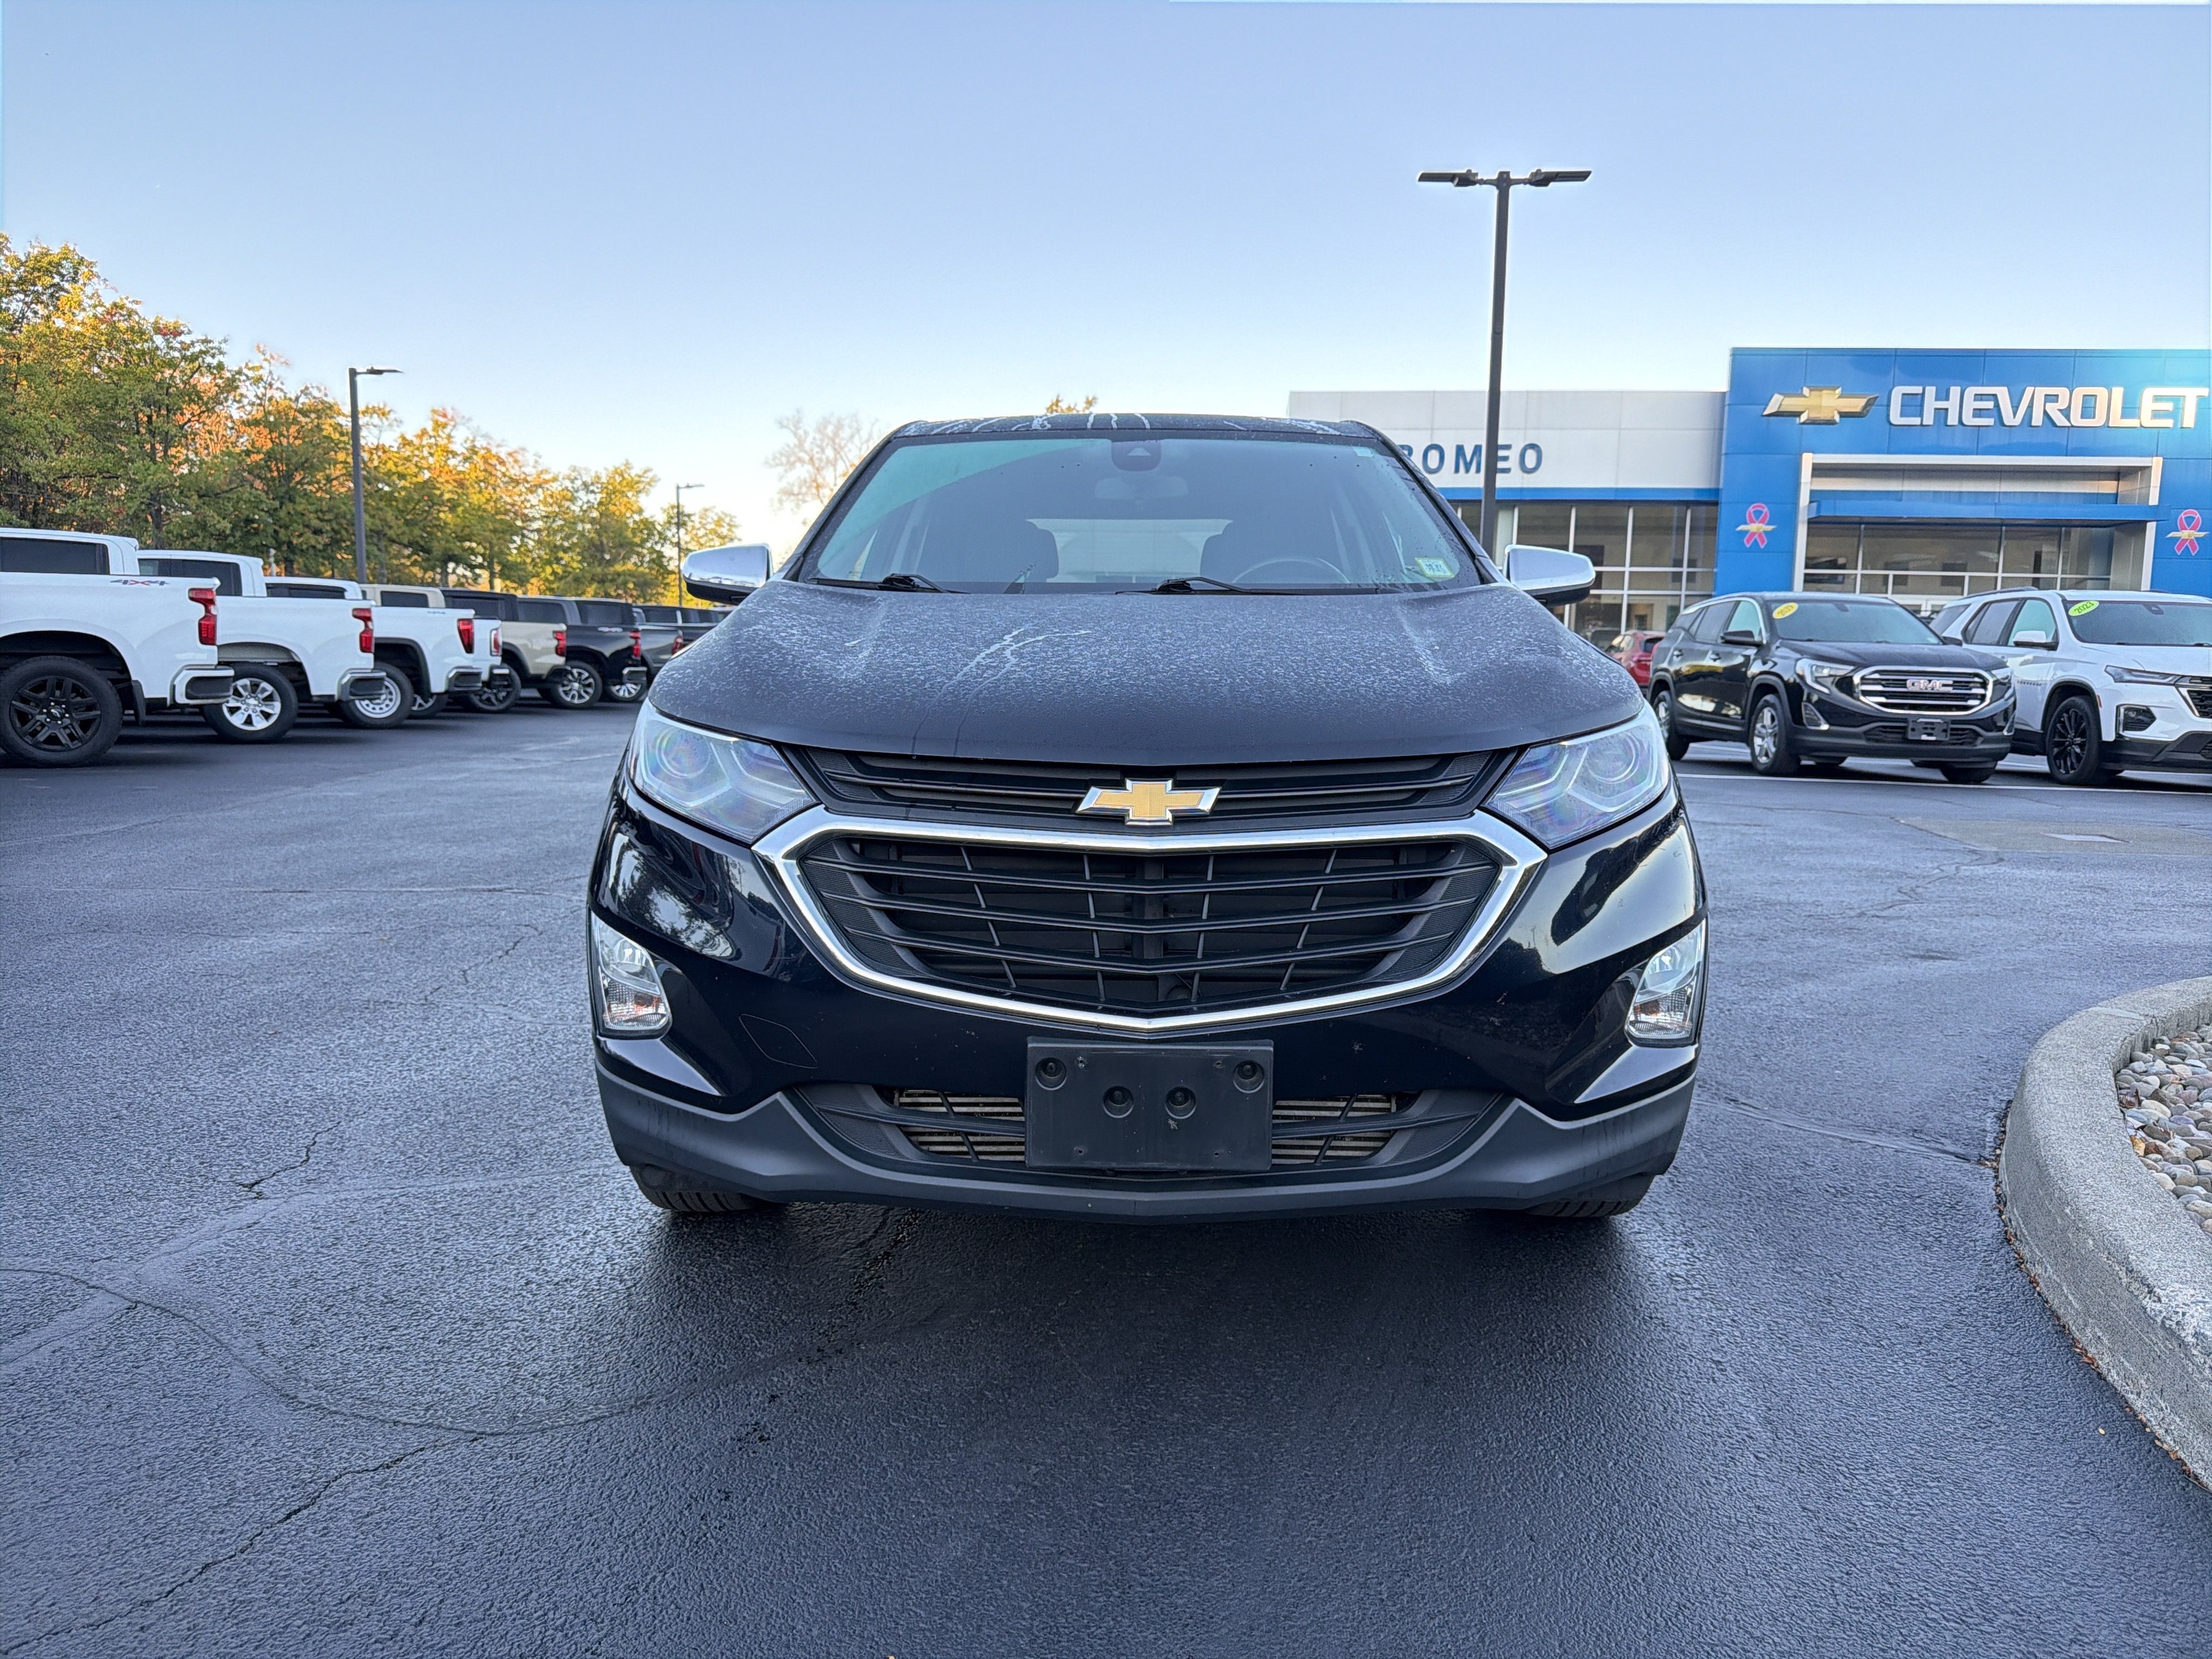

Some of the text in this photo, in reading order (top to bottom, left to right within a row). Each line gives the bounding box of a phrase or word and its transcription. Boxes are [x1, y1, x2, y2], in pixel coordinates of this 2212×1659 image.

[1889, 386, 2209, 428] CHEVROLET
[2074, 602, 2095, 614] 2023
[1906, 679, 1954, 691] GMC
